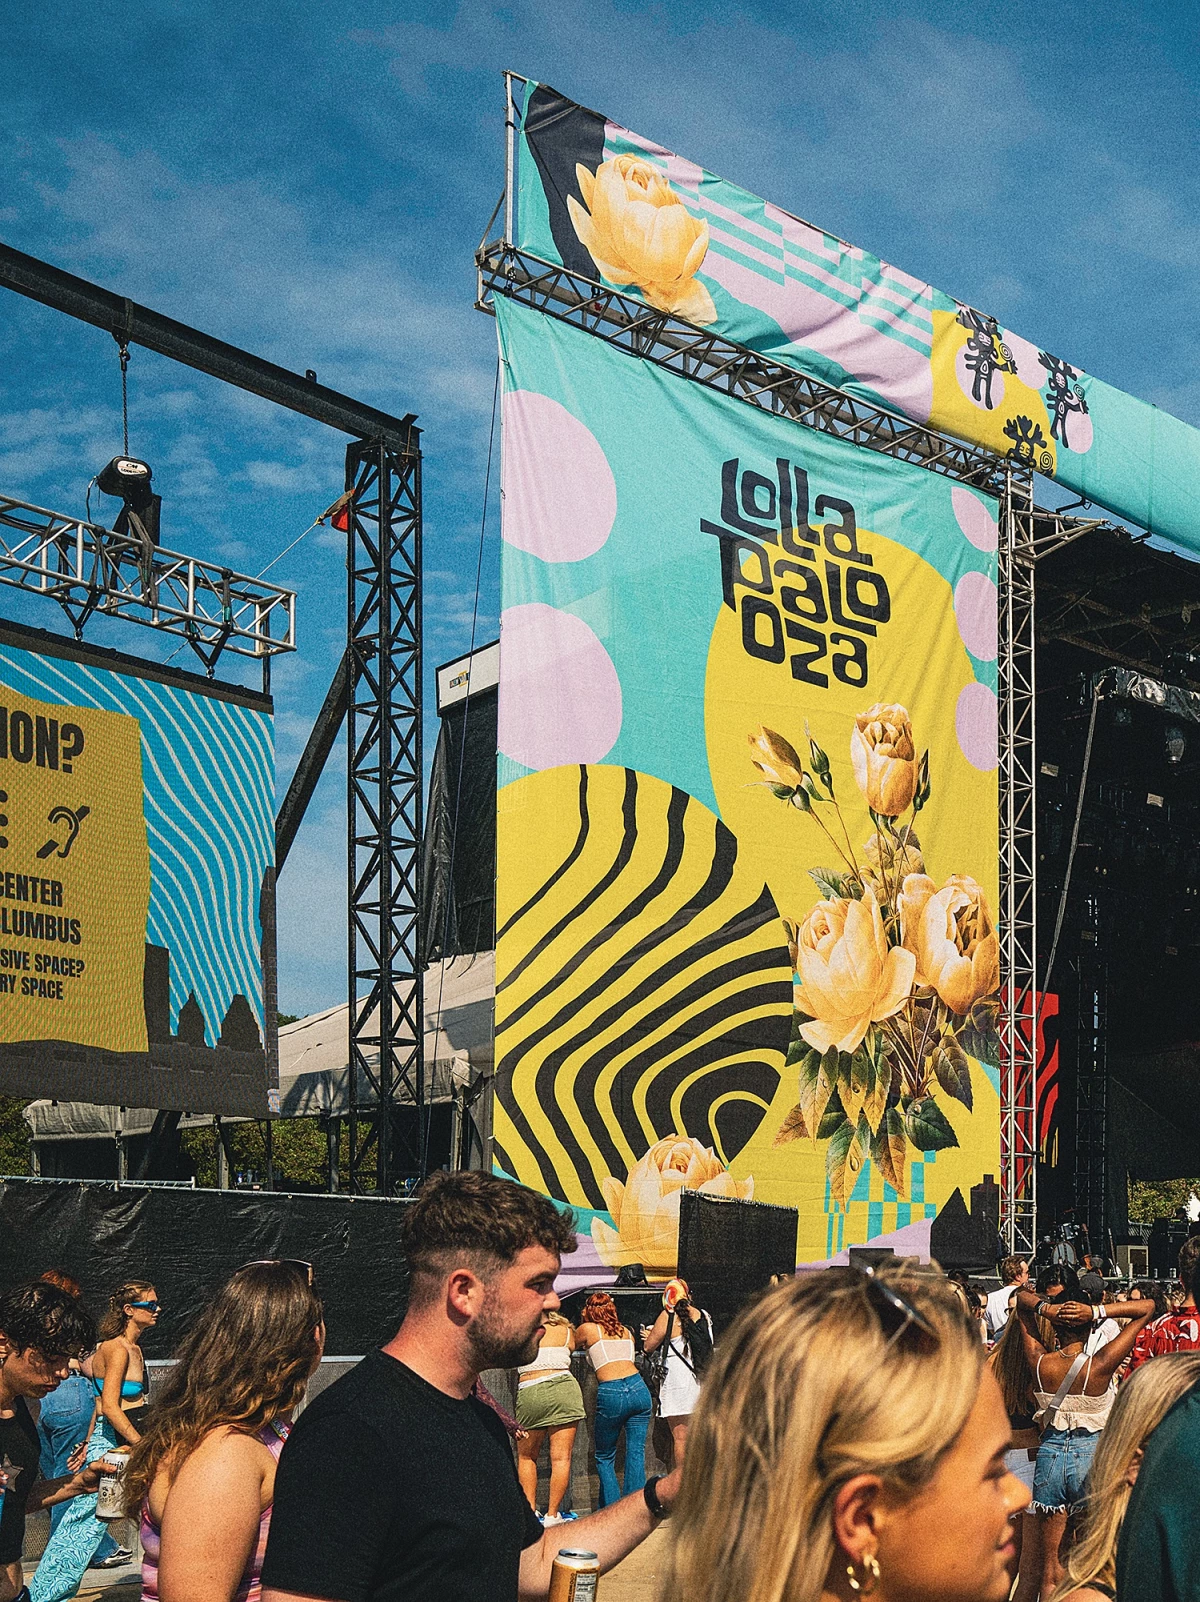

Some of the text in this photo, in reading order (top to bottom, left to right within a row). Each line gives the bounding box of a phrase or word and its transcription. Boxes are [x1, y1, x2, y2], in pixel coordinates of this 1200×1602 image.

[1, 907, 81, 945] LUMBUS
[0, 948, 85, 978] SIVE SPACE?
[21, 976, 64, 1000] SPACE
